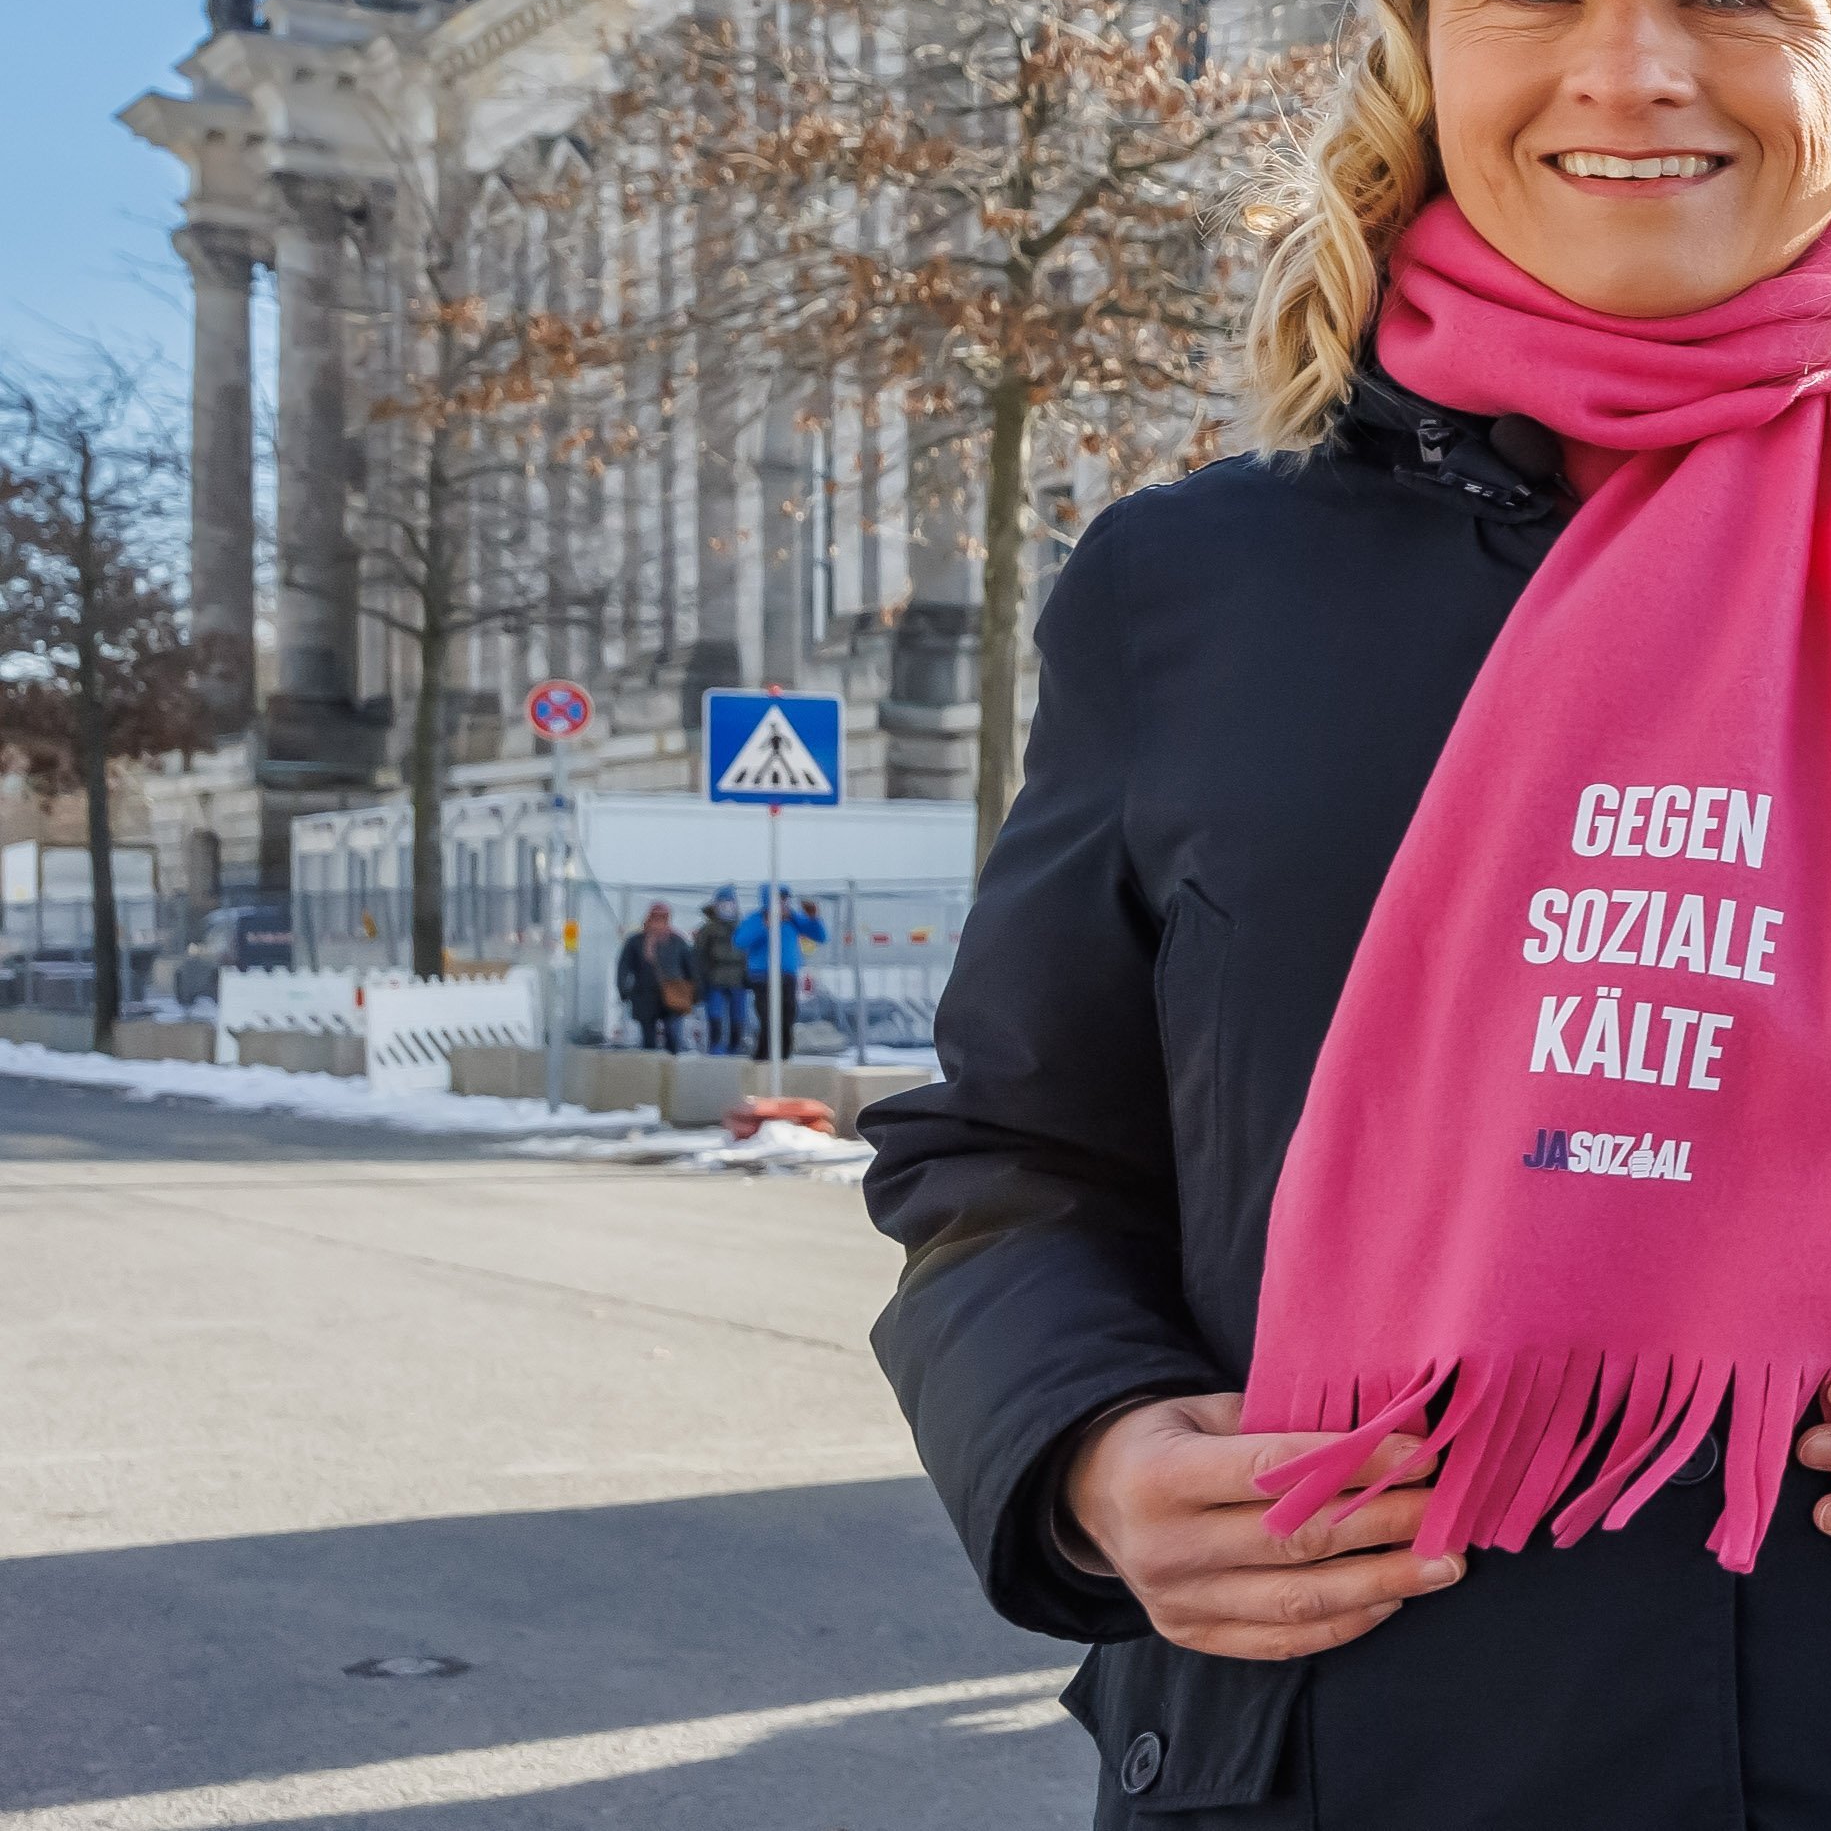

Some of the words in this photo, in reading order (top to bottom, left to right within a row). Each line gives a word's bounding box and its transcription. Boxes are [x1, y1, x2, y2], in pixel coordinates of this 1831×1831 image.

[1571, 783, 1774, 870] GEGEN
[1522, 888, 1785, 986] SOZIALE
[1528, 986, 1735, 1092] KÄLTE
